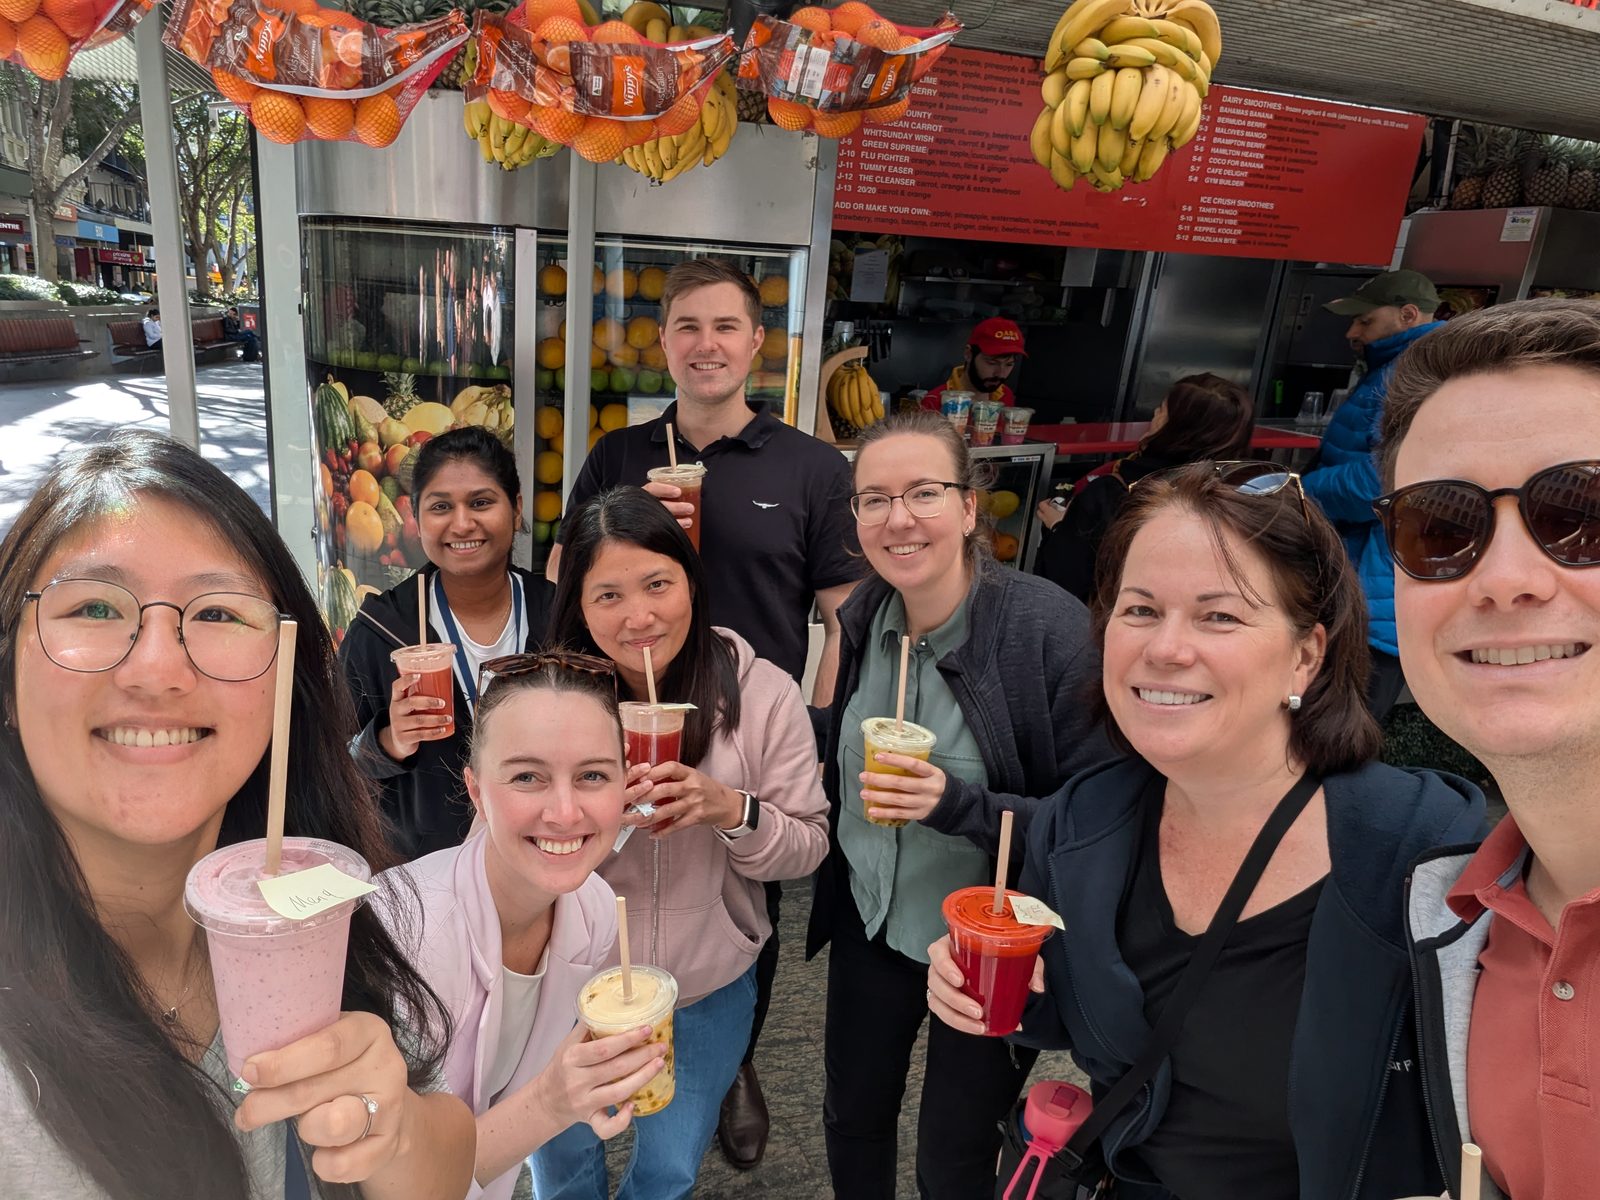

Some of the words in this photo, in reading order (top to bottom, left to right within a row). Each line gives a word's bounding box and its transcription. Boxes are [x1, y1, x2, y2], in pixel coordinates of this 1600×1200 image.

[1222, 95, 1244, 105] DAIRY
[1244, 98, 1282, 110] SMOOTHIES
[1202, 103, 1212, 112] S-1
[1219, 106, 1249, 116] BAHAMAS
[1249, 110, 1274, 120] BANANA
[910, 122, 943, 133] CARROT
[1216, 116, 1246, 126] BERMUDA
[1246, 120, 1267, 130] BERRY
[863, 128, 914, 140] WHITSUNDAY
[914, 134, 934, 143] WISH
[1214, 126, 1245, 137] MALDIVES
[1245, 130, 1268, 140] MANGO
[840, 138, 852, 146] J-9
[861, 140, 890, 149] GREEN
[890, 142, 928, 154] SUPREME
[1212, 137, 1246, 147] BRAMPTON
[1246, 140, 1266, 149] BERRY
[839, 149, 856, 158] J-10
[860, 151, 876, 160] FLU
[876, 153, 910, 164] FIGHTER
[1210, 148, 1241, 157] HAMILTON
[1241, 151, 1265, 160] HEAVEN
[838, 160, 854, 168] J-11
[859, 162, 887, 172] TUMMY
[888, 164, 914, 175] EASER
[1189, 165, 1200, 173] S-7
[1206, 167, 1223, 175] CAFE
[1223, 169, 1248, 178] DELIGHT
[1240, 161, 1265, 170] BANANA
[836, 172, 854, 181] J-12
[859, 174, 874, 182] THE
[874, 176, 916, 187] CLEANSER
[1204, 177, 1218, 186] GYM
[1218, 178, 1245, 188] BUILDER
[836, 184, 852, 192] J-13
[856, 186, 878, 194] 20/20
[834, 200, 852, 209] ADD
[852, 202, 864, 210] OR
[865, 204, 888, 212] MAKE
[888, 206, 910, 214] YOUR
[910, 207, 932, 216] OWN:
[1200, 196, 1212, 204] ICE
[1212, 198, 1236, 206] CRUSH
[1236, 200, 1276, 210] SMOOTHIES
[1198, 206, 1217, 214] TAHITI
[1218, 208, 1238, 216] TANGO
[1196, 216, 1224, 224] VANUATU
[1224, 218, 1238, 226] VIBE
[1177, 224, 1190, 232] S-11
[1194, 226, 1218, 234] KEPPEL
[1218, 228, 1242, 236] KOOLER
[1192, 235, 1223, 244] BRAZILIAN
